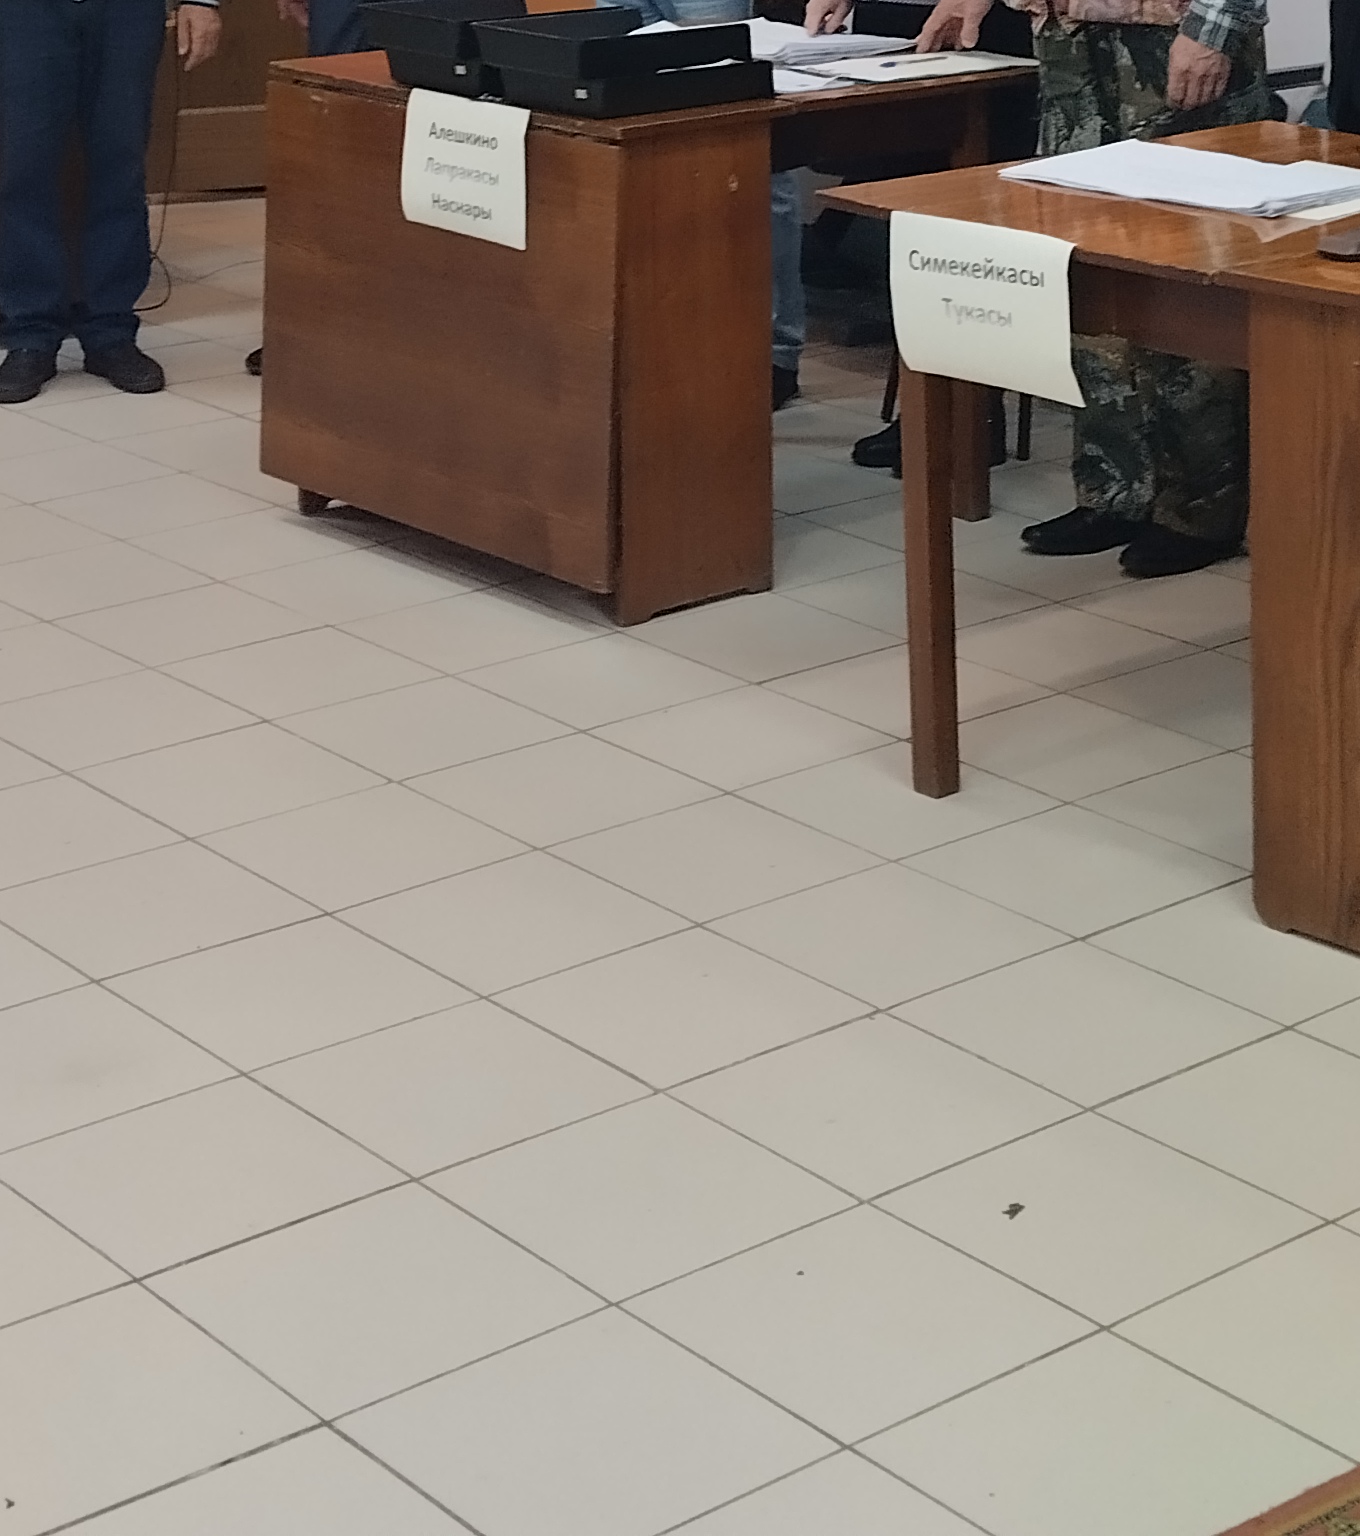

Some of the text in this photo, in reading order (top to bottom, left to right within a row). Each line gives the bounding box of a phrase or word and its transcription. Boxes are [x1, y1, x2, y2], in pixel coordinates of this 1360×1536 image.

[428, 122, 499, 150] Алешкино
[430, 193, 493, 221] Наскары
[908, 249, 1045, 288] Симекейкасы
[941, 297, 1013, 328] Тукасы
